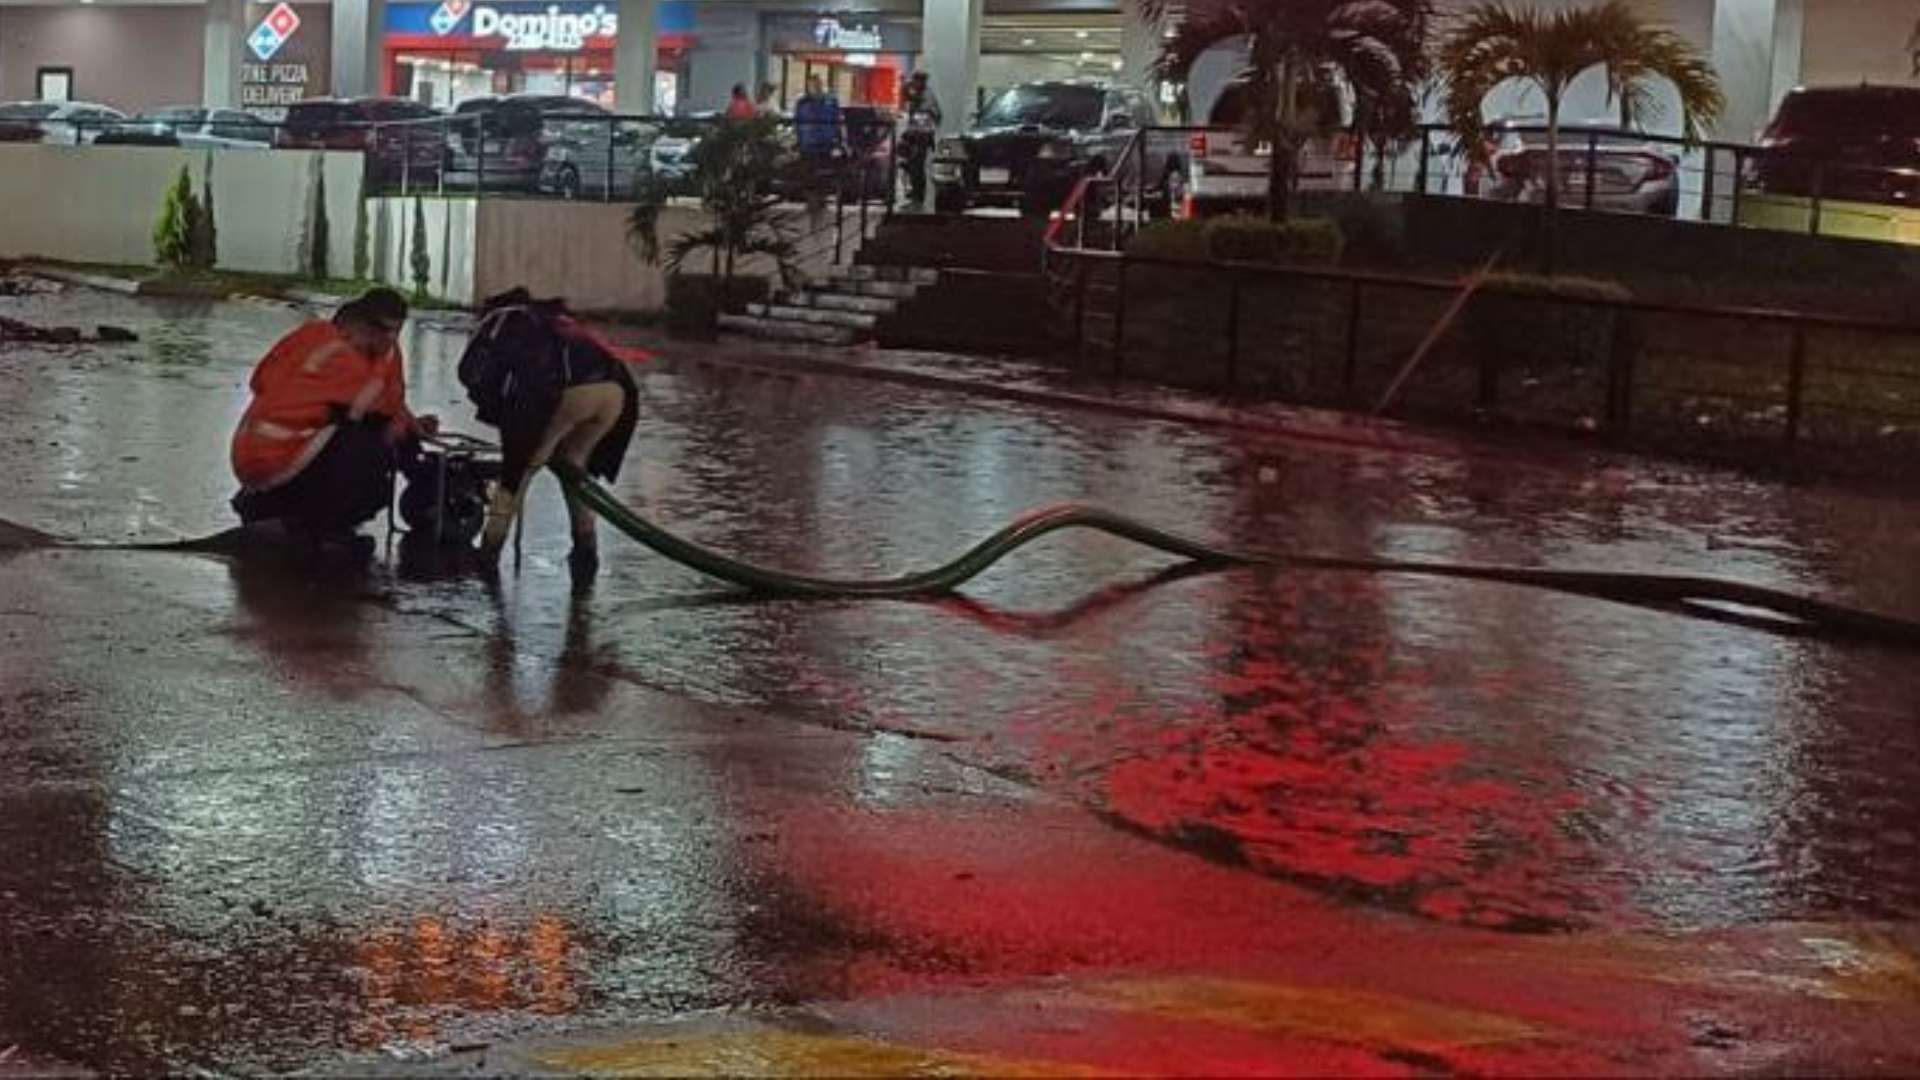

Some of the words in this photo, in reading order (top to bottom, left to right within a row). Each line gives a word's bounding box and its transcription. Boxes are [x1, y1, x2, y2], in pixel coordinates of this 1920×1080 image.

[472, 5, 618, 37] Domino's
[242, 64, 269, 82] THE
[272, 64, 308, 82] PIZZA
[243, 86, 304, 105] DELIVERY
